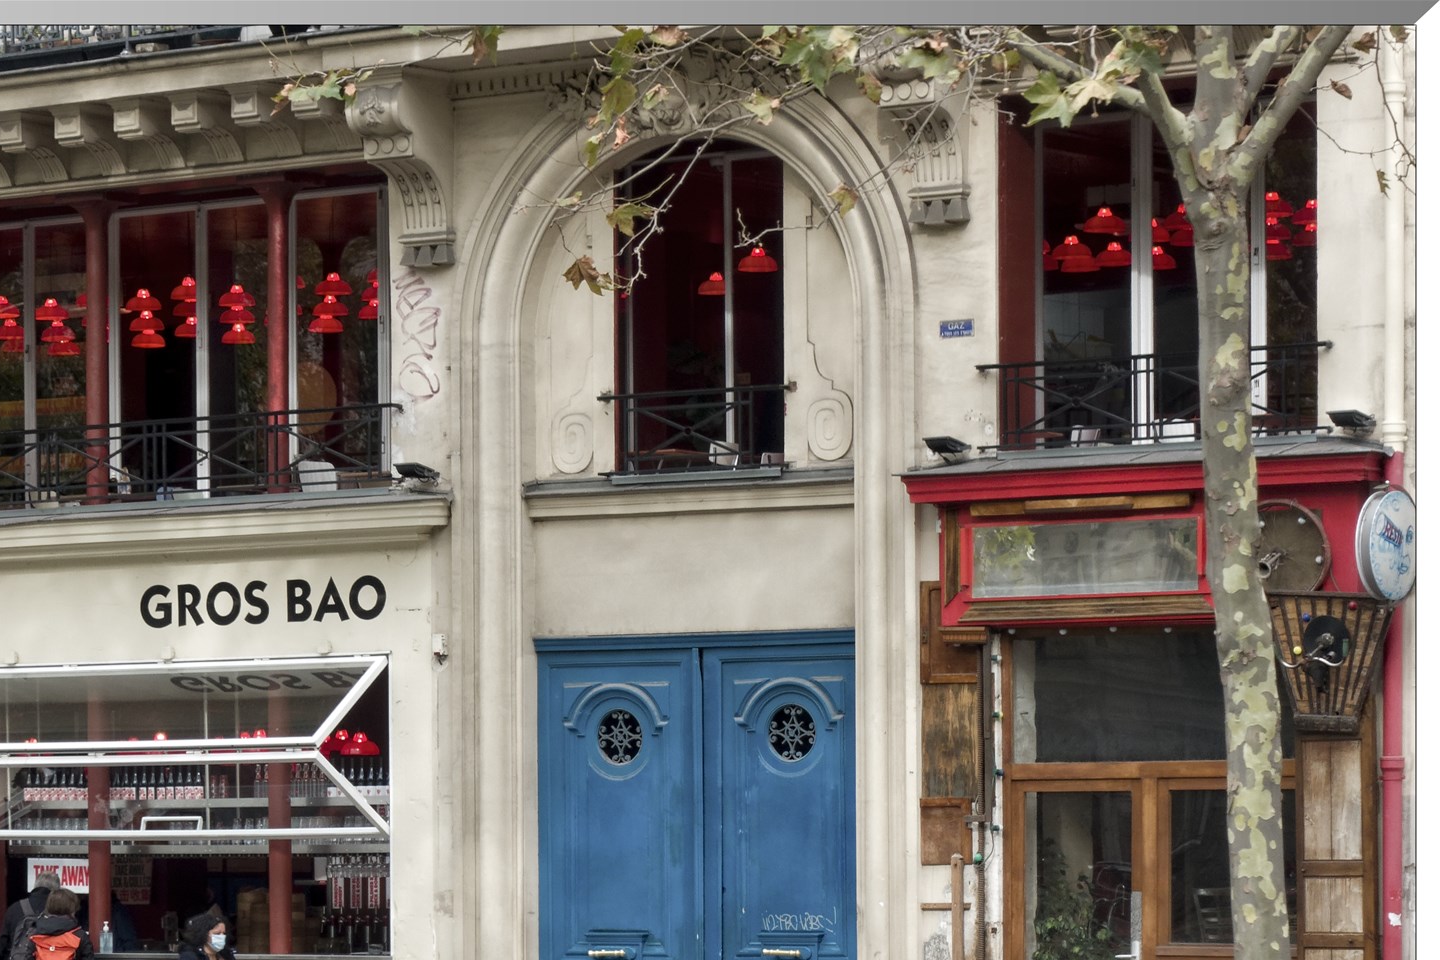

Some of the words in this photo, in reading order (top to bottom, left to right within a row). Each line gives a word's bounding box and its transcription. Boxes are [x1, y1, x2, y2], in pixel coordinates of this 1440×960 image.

[947, 321, 965, 331] GAZ
[140, 580, 270, 629] GROS
[286, 575, 387, 623] BAO
[61, 866, 89, 887] AWAY
